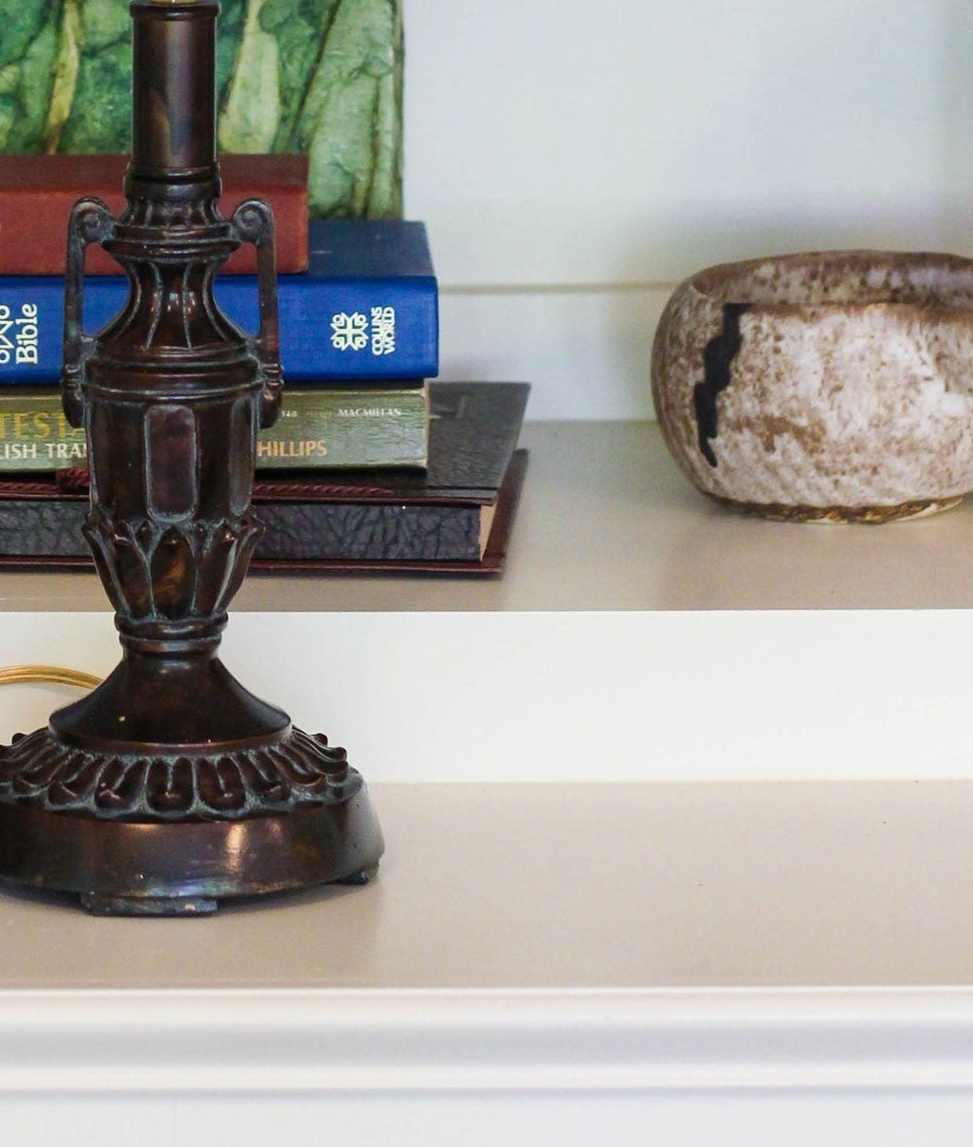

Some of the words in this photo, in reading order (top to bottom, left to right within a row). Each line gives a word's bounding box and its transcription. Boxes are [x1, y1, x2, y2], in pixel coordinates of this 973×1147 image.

[15, 303, 38, 365] Bible
[371, 306, 384, 356] COLLINS
[384, 306, 396, 356] WORLD
[256, 439, 328, 457] HILLIPS
